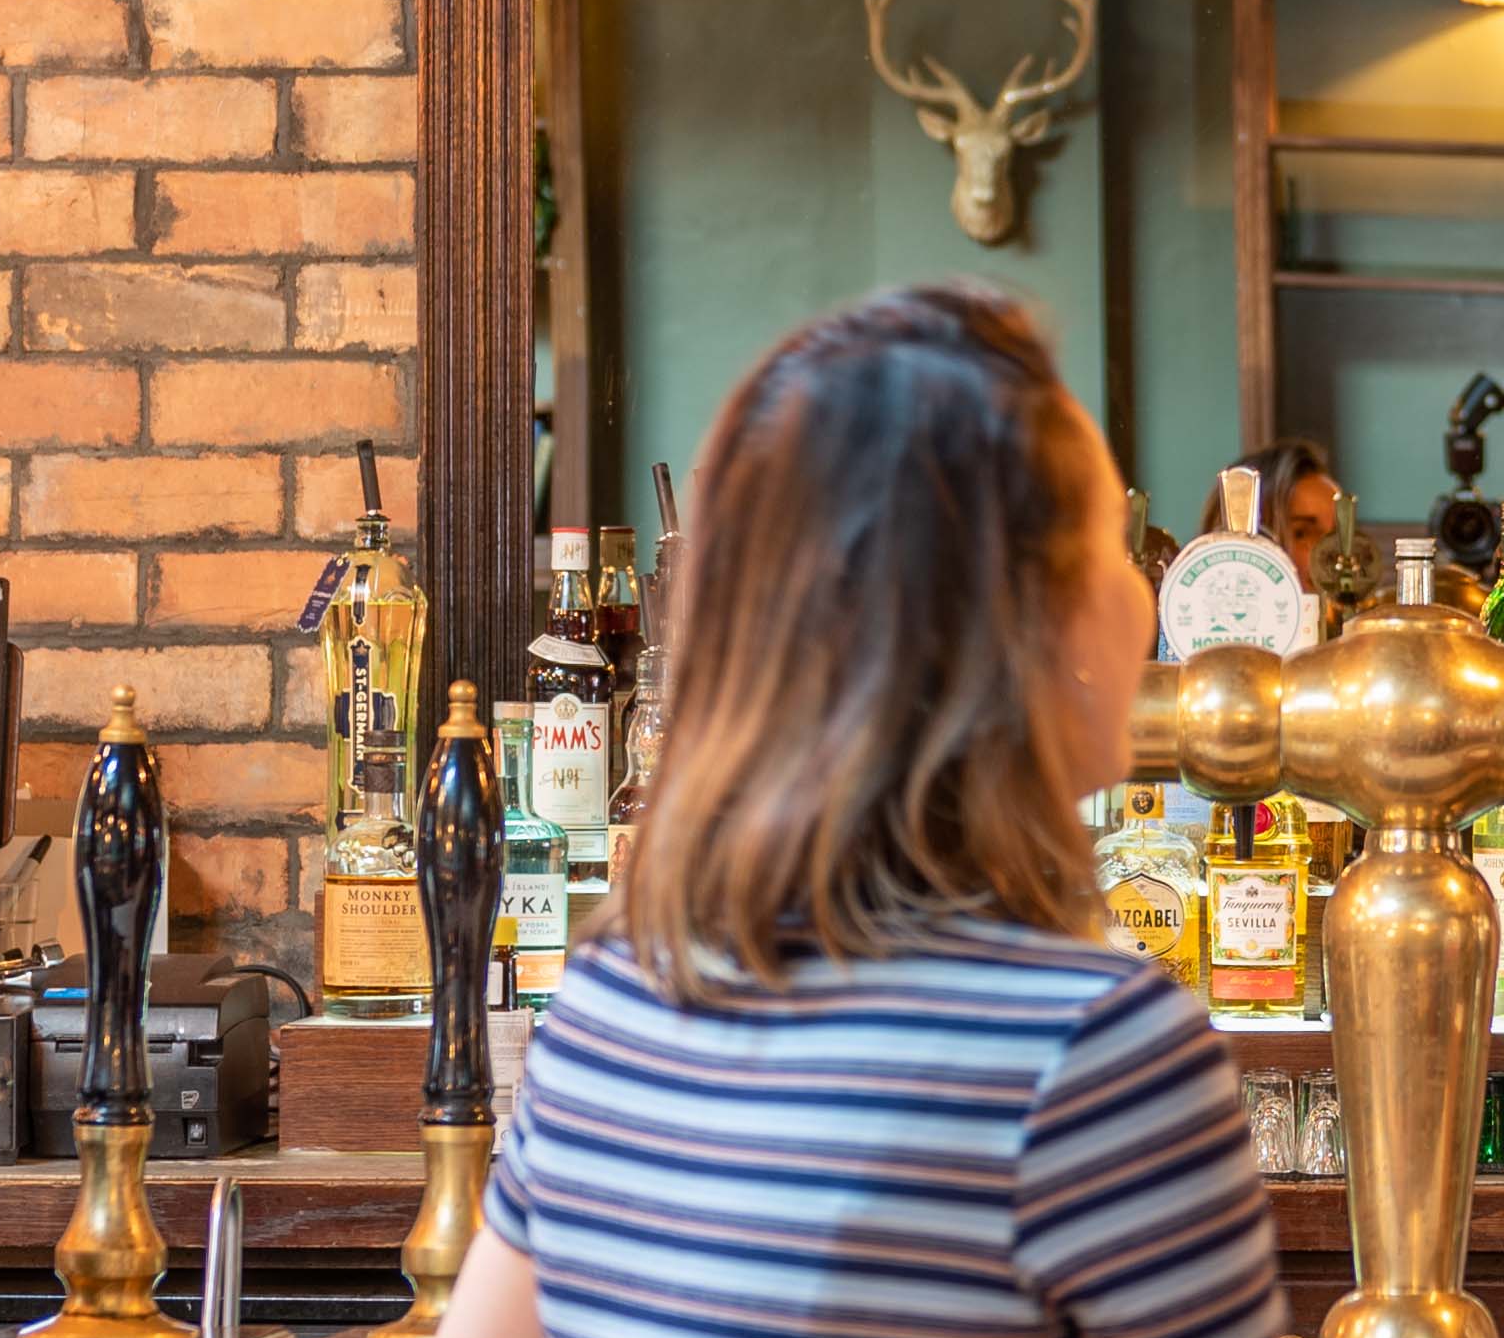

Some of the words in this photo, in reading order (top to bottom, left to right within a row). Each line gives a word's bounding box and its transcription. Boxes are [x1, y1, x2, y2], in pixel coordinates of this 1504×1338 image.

[532, 720, 603, 751] PIMM'S
[348, 889, 412, 902] MONKEY
[341, 903, 417, 916] SHOULDER
[502, 896, 553, 914] YKA
[1223, 896, 1284, 913] Tanqueray
[1227, 917, 1277, 929] SEVILLA
